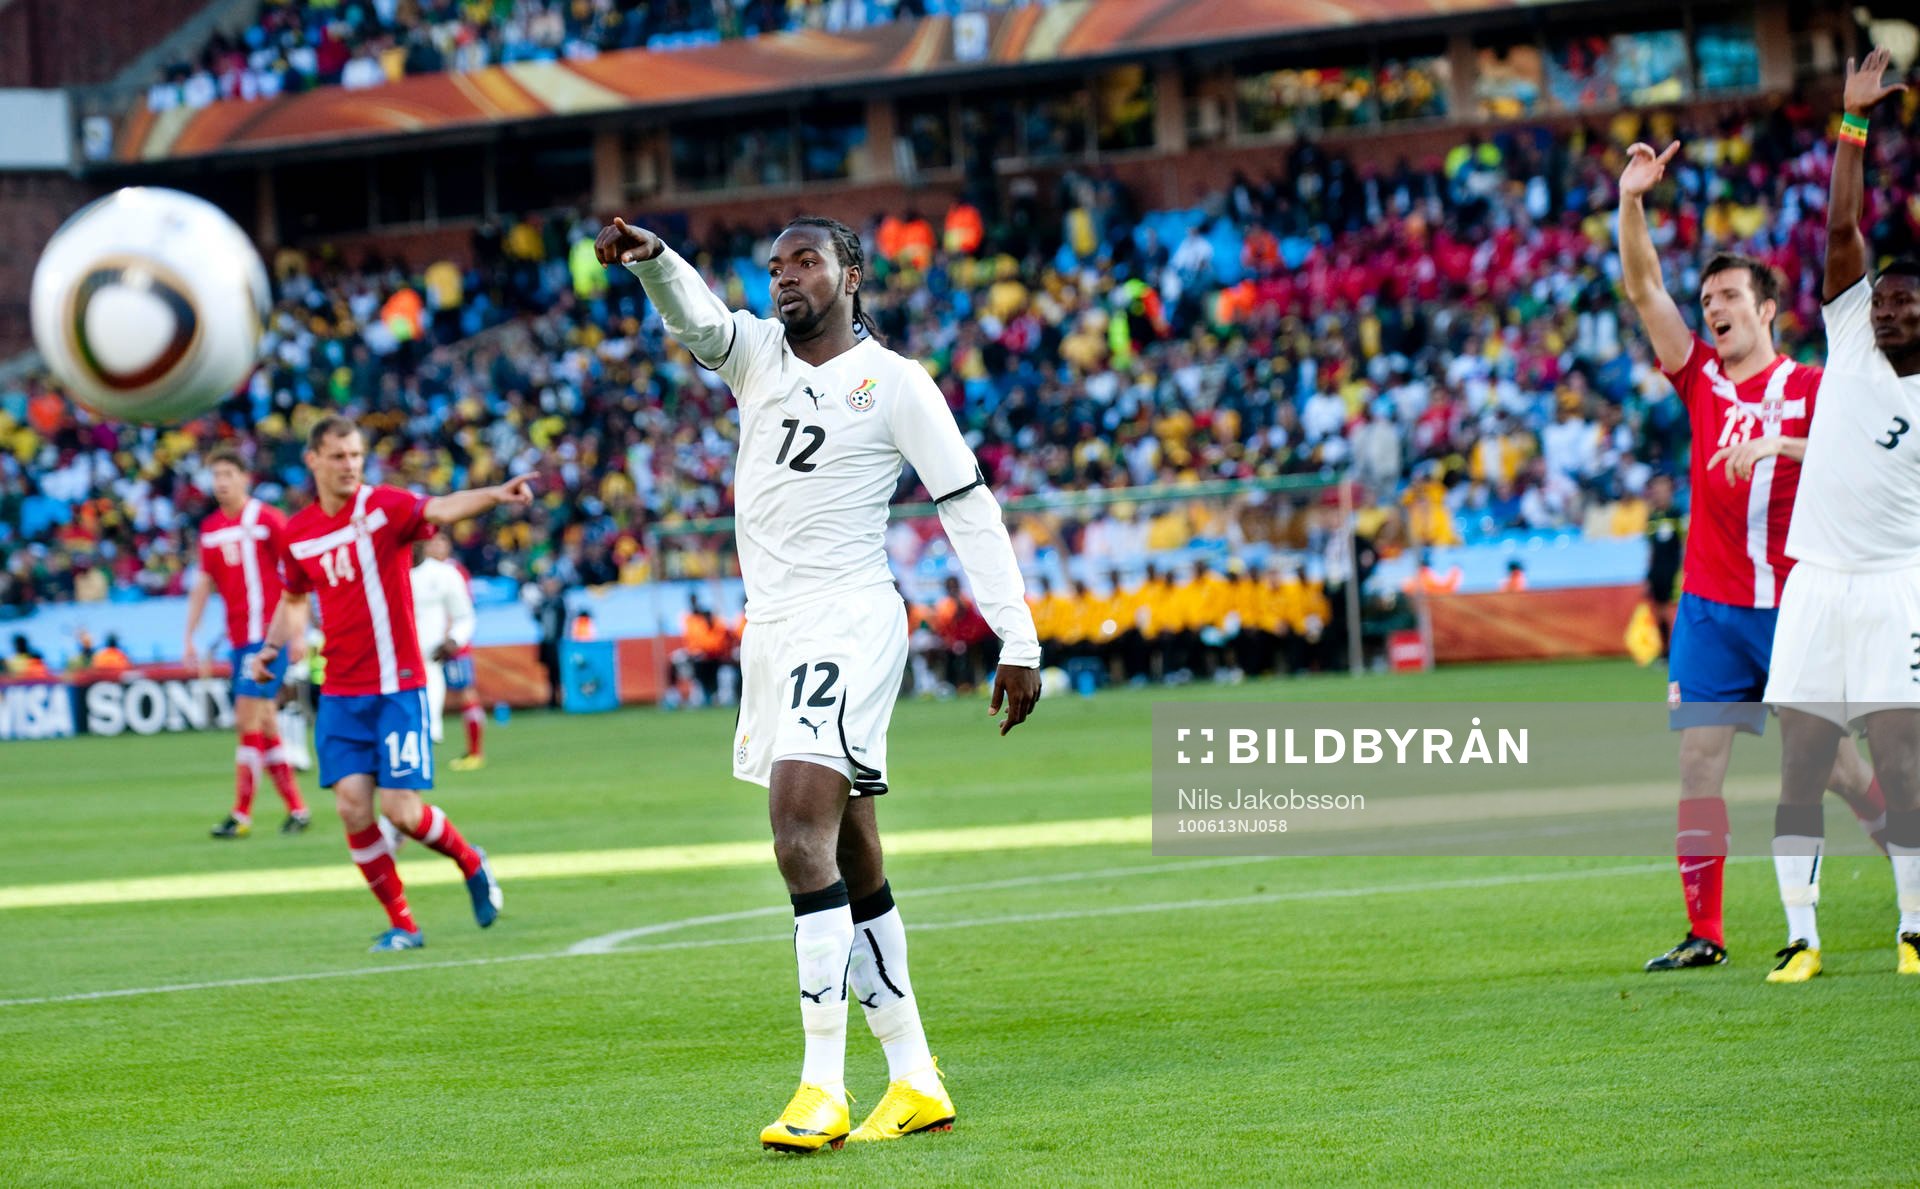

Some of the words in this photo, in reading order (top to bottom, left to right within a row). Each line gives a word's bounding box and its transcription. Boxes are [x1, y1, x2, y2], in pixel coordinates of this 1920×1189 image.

[776, 418, 826, 473] 12
[1717, 404, 1756, 448] 13
[1875, 416, 1910, 450] 3
[320, 545, 356, 587] 14
[790, 661, 840, 710] 12
[384, 731, 420, 769] 14
